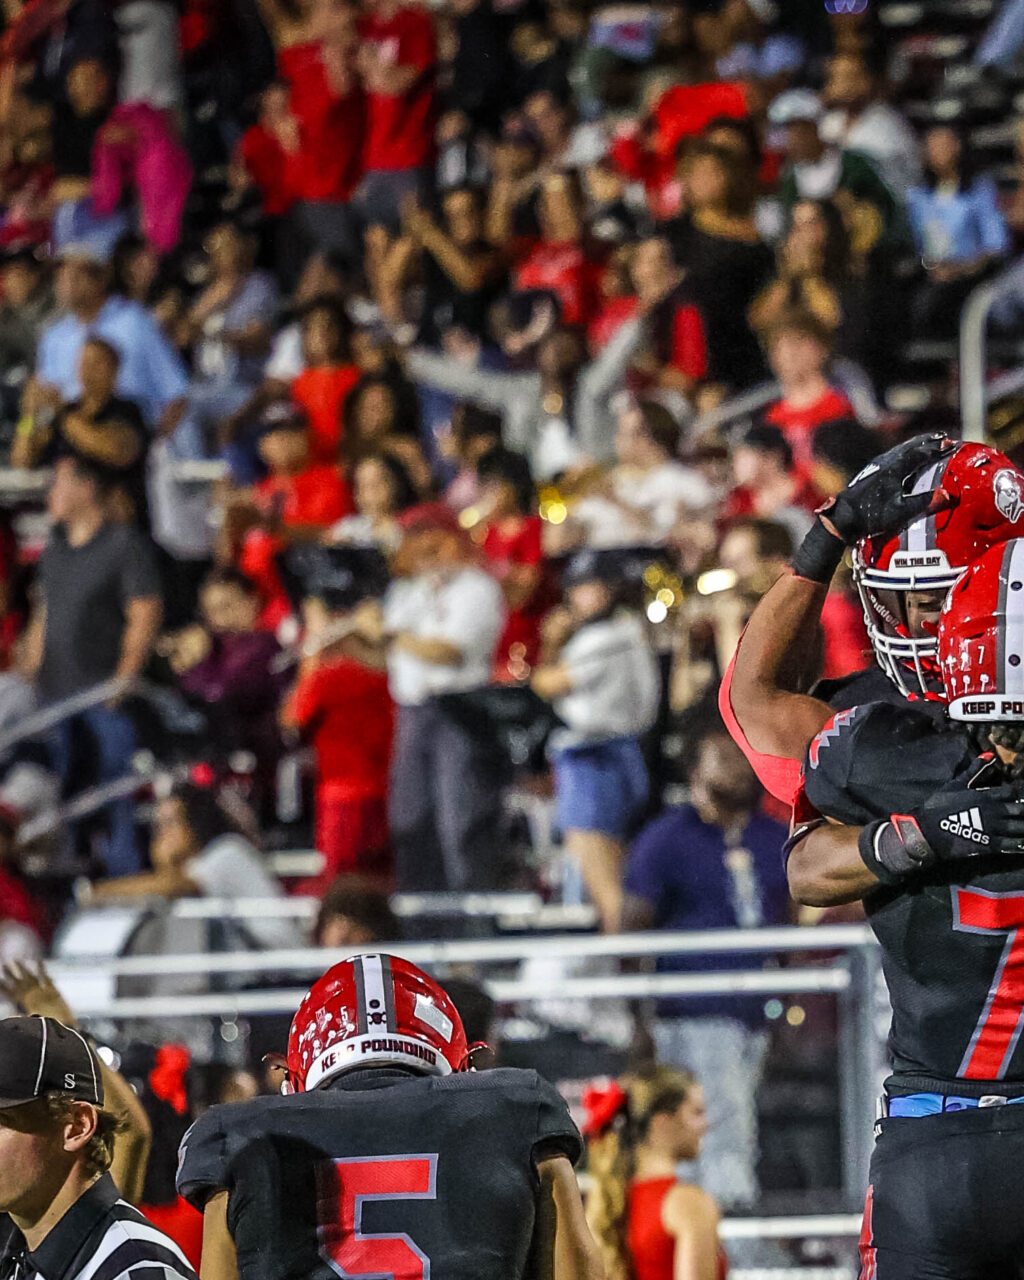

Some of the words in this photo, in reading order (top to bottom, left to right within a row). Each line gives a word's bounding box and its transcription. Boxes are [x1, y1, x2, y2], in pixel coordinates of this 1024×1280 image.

[977, 645, 985, 664] 7
[962, 701, 996, 715] KEEP
[940, 819, 990, 845] adidas
[361, 1038, 437, 1066] POUNDING
